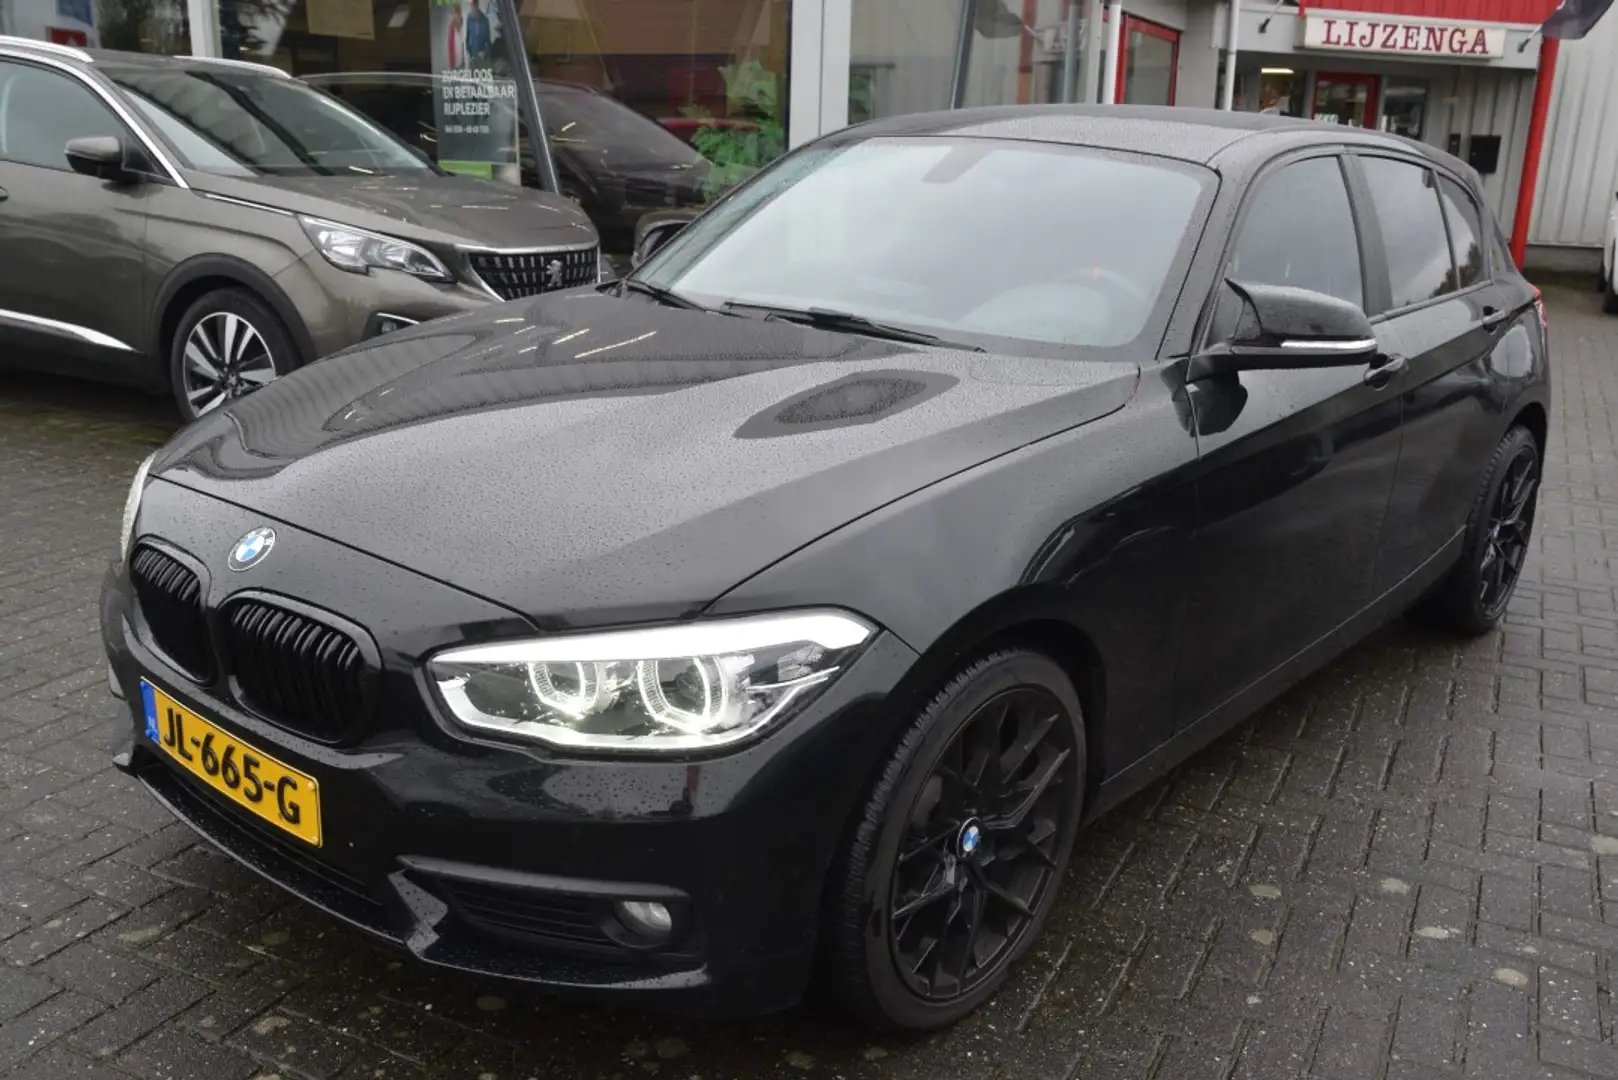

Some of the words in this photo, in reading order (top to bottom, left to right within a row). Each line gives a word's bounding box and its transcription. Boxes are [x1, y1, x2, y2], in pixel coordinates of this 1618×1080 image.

[1321, 19, 1489, 55] LIJZENGA
[443, 86, 454, 99] EN
[454, 84, 515, 99] BETAALBAAR
[444, 102, 490, 115] RIJPLEZIER
[163, 707, 301, 825] JL-665-G
